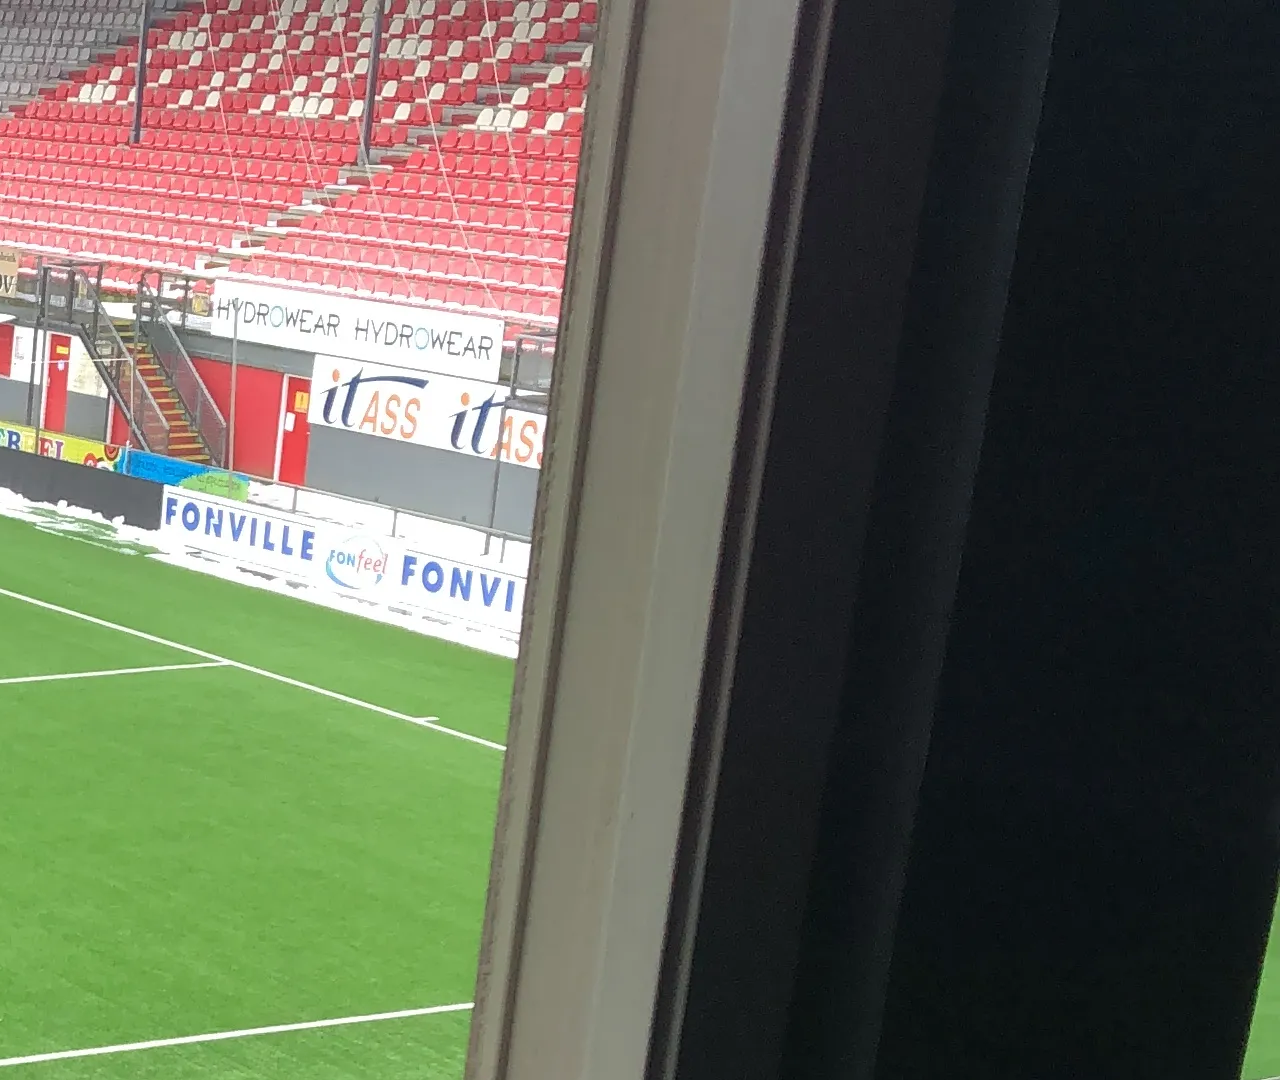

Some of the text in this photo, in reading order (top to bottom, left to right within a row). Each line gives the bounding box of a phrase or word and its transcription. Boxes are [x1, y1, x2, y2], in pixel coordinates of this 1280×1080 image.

[217, 297, 494, 361] HYDROWEAR HYDROWEAR
[165, 497, 315, 561] FONVILLE
[401, 554, 515, 612] FONVI
